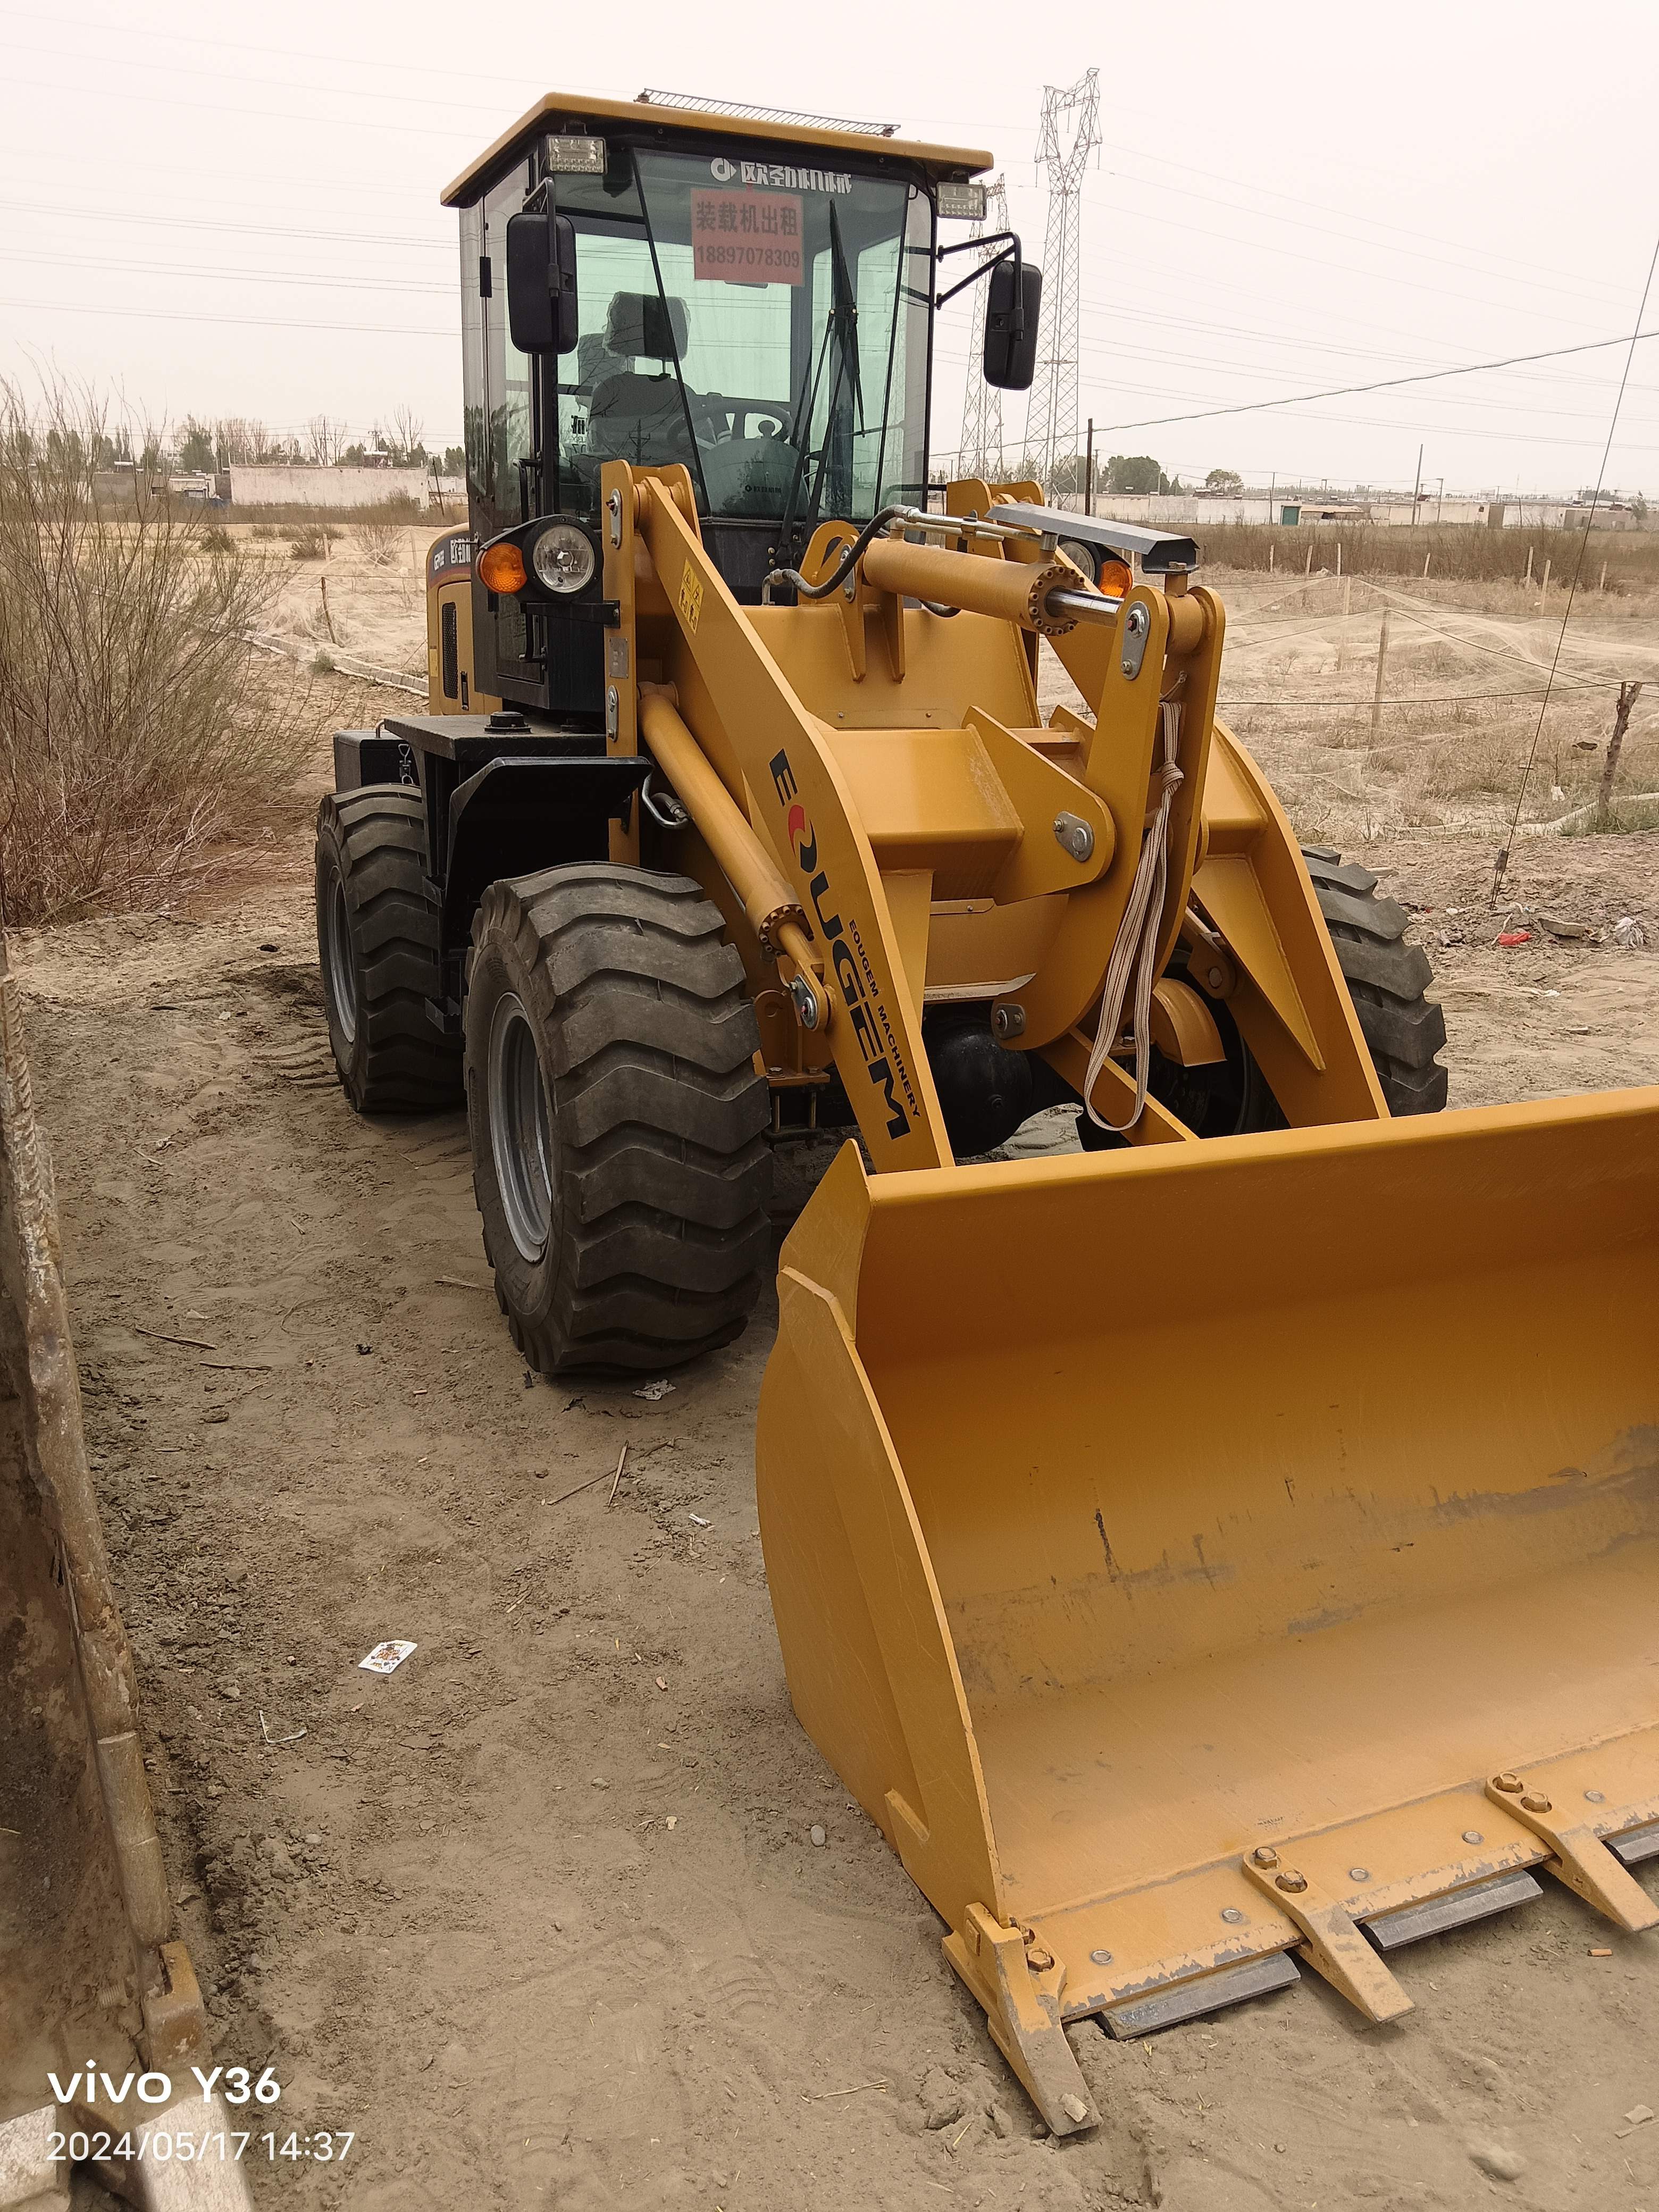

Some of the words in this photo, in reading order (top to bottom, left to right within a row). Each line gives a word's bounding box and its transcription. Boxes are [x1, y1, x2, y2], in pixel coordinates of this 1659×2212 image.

[740, 161, 852, 194] 欧劲机械
[697, 201, 798, 236] 装载机出租
[697, 246, 800, 268] 18897078309
[849, 919, 879, 998] EOUGEM
[877, 1004, 921, 1118] MACHINERY
